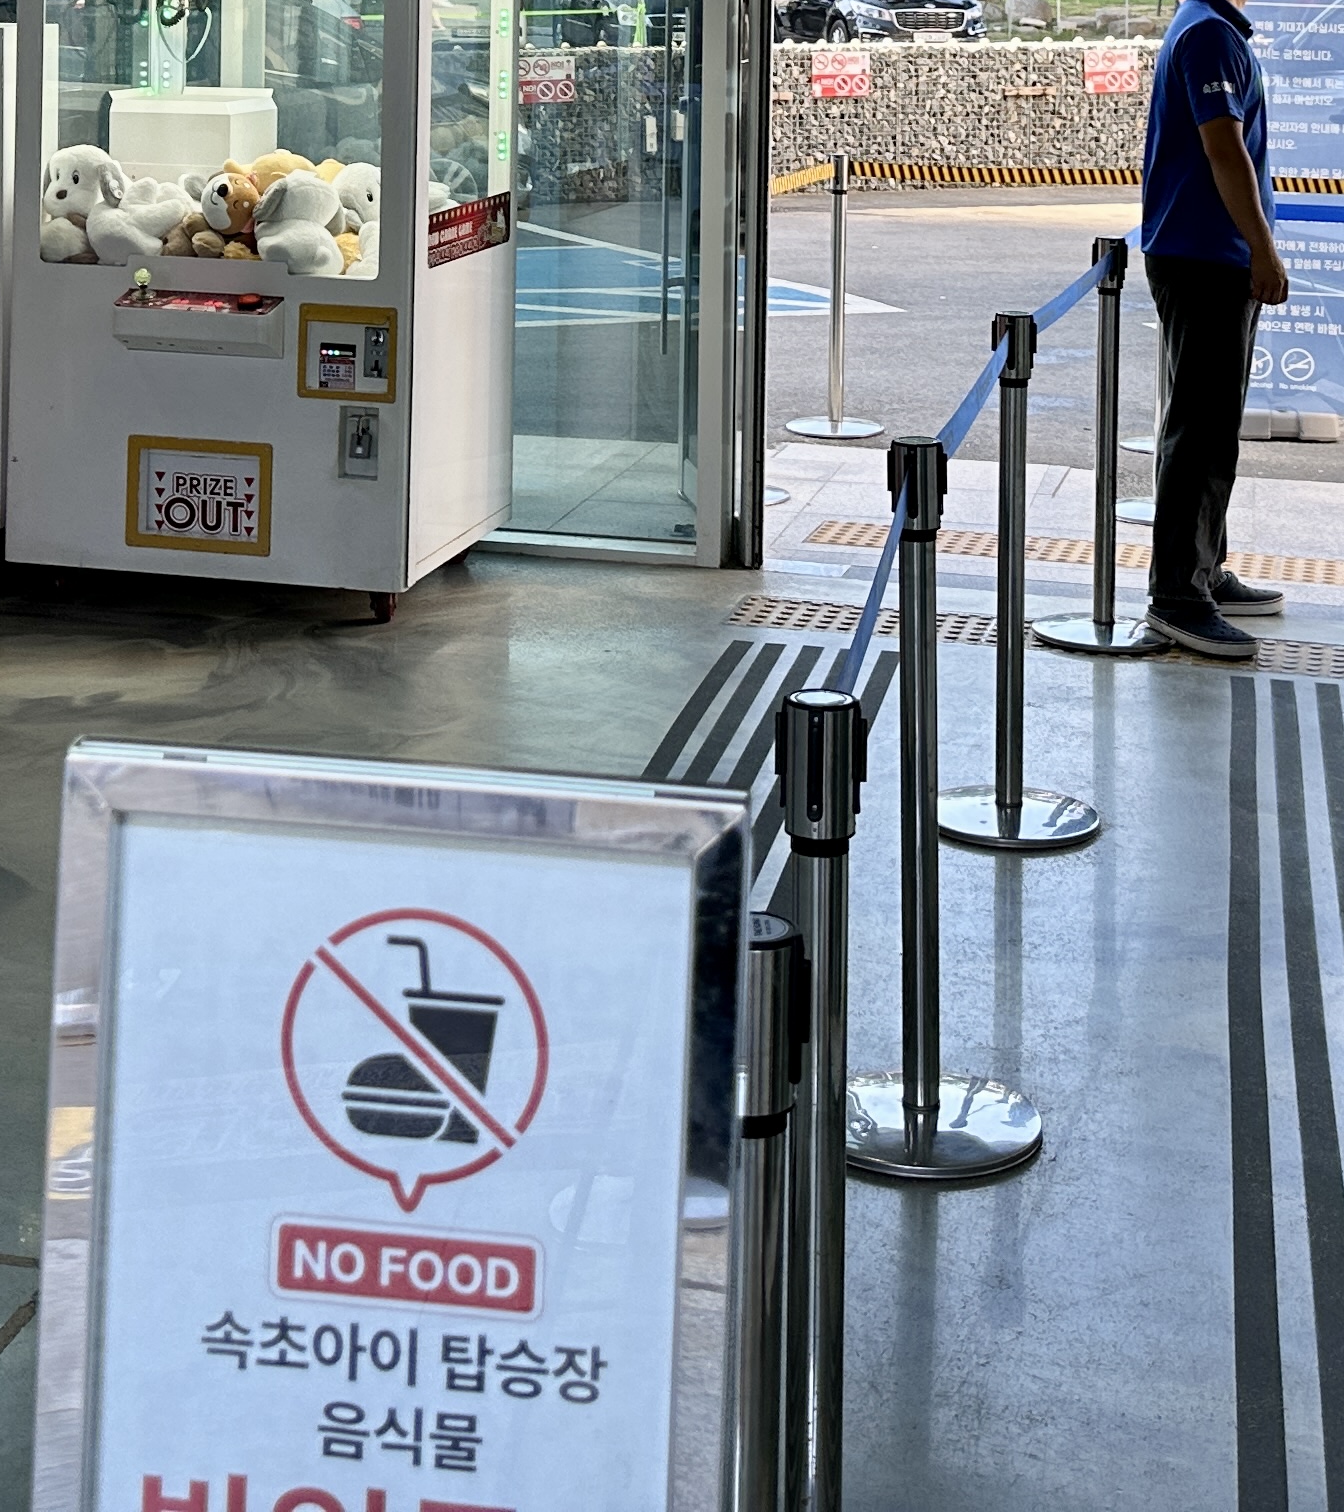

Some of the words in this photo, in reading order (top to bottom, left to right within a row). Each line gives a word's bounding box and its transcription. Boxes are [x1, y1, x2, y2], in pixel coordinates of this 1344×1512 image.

[1290, 305, 1311, 317] 발생
[1314, 305, 1325, 317] 시
[1294, 322, 1315, 335] 연락
[173, 473, 236, 499] PRIZE
[163, 495, 246, 534] OUT
[293, 1240, 365, 1285] NO
[379, 1248, 520, 1298] FOOD
[201, 1310, 419, 1386] 속초아이
[440, 1332, 608, 1405] 탑승장
[317, 1399, 483, 1475] 음식물
